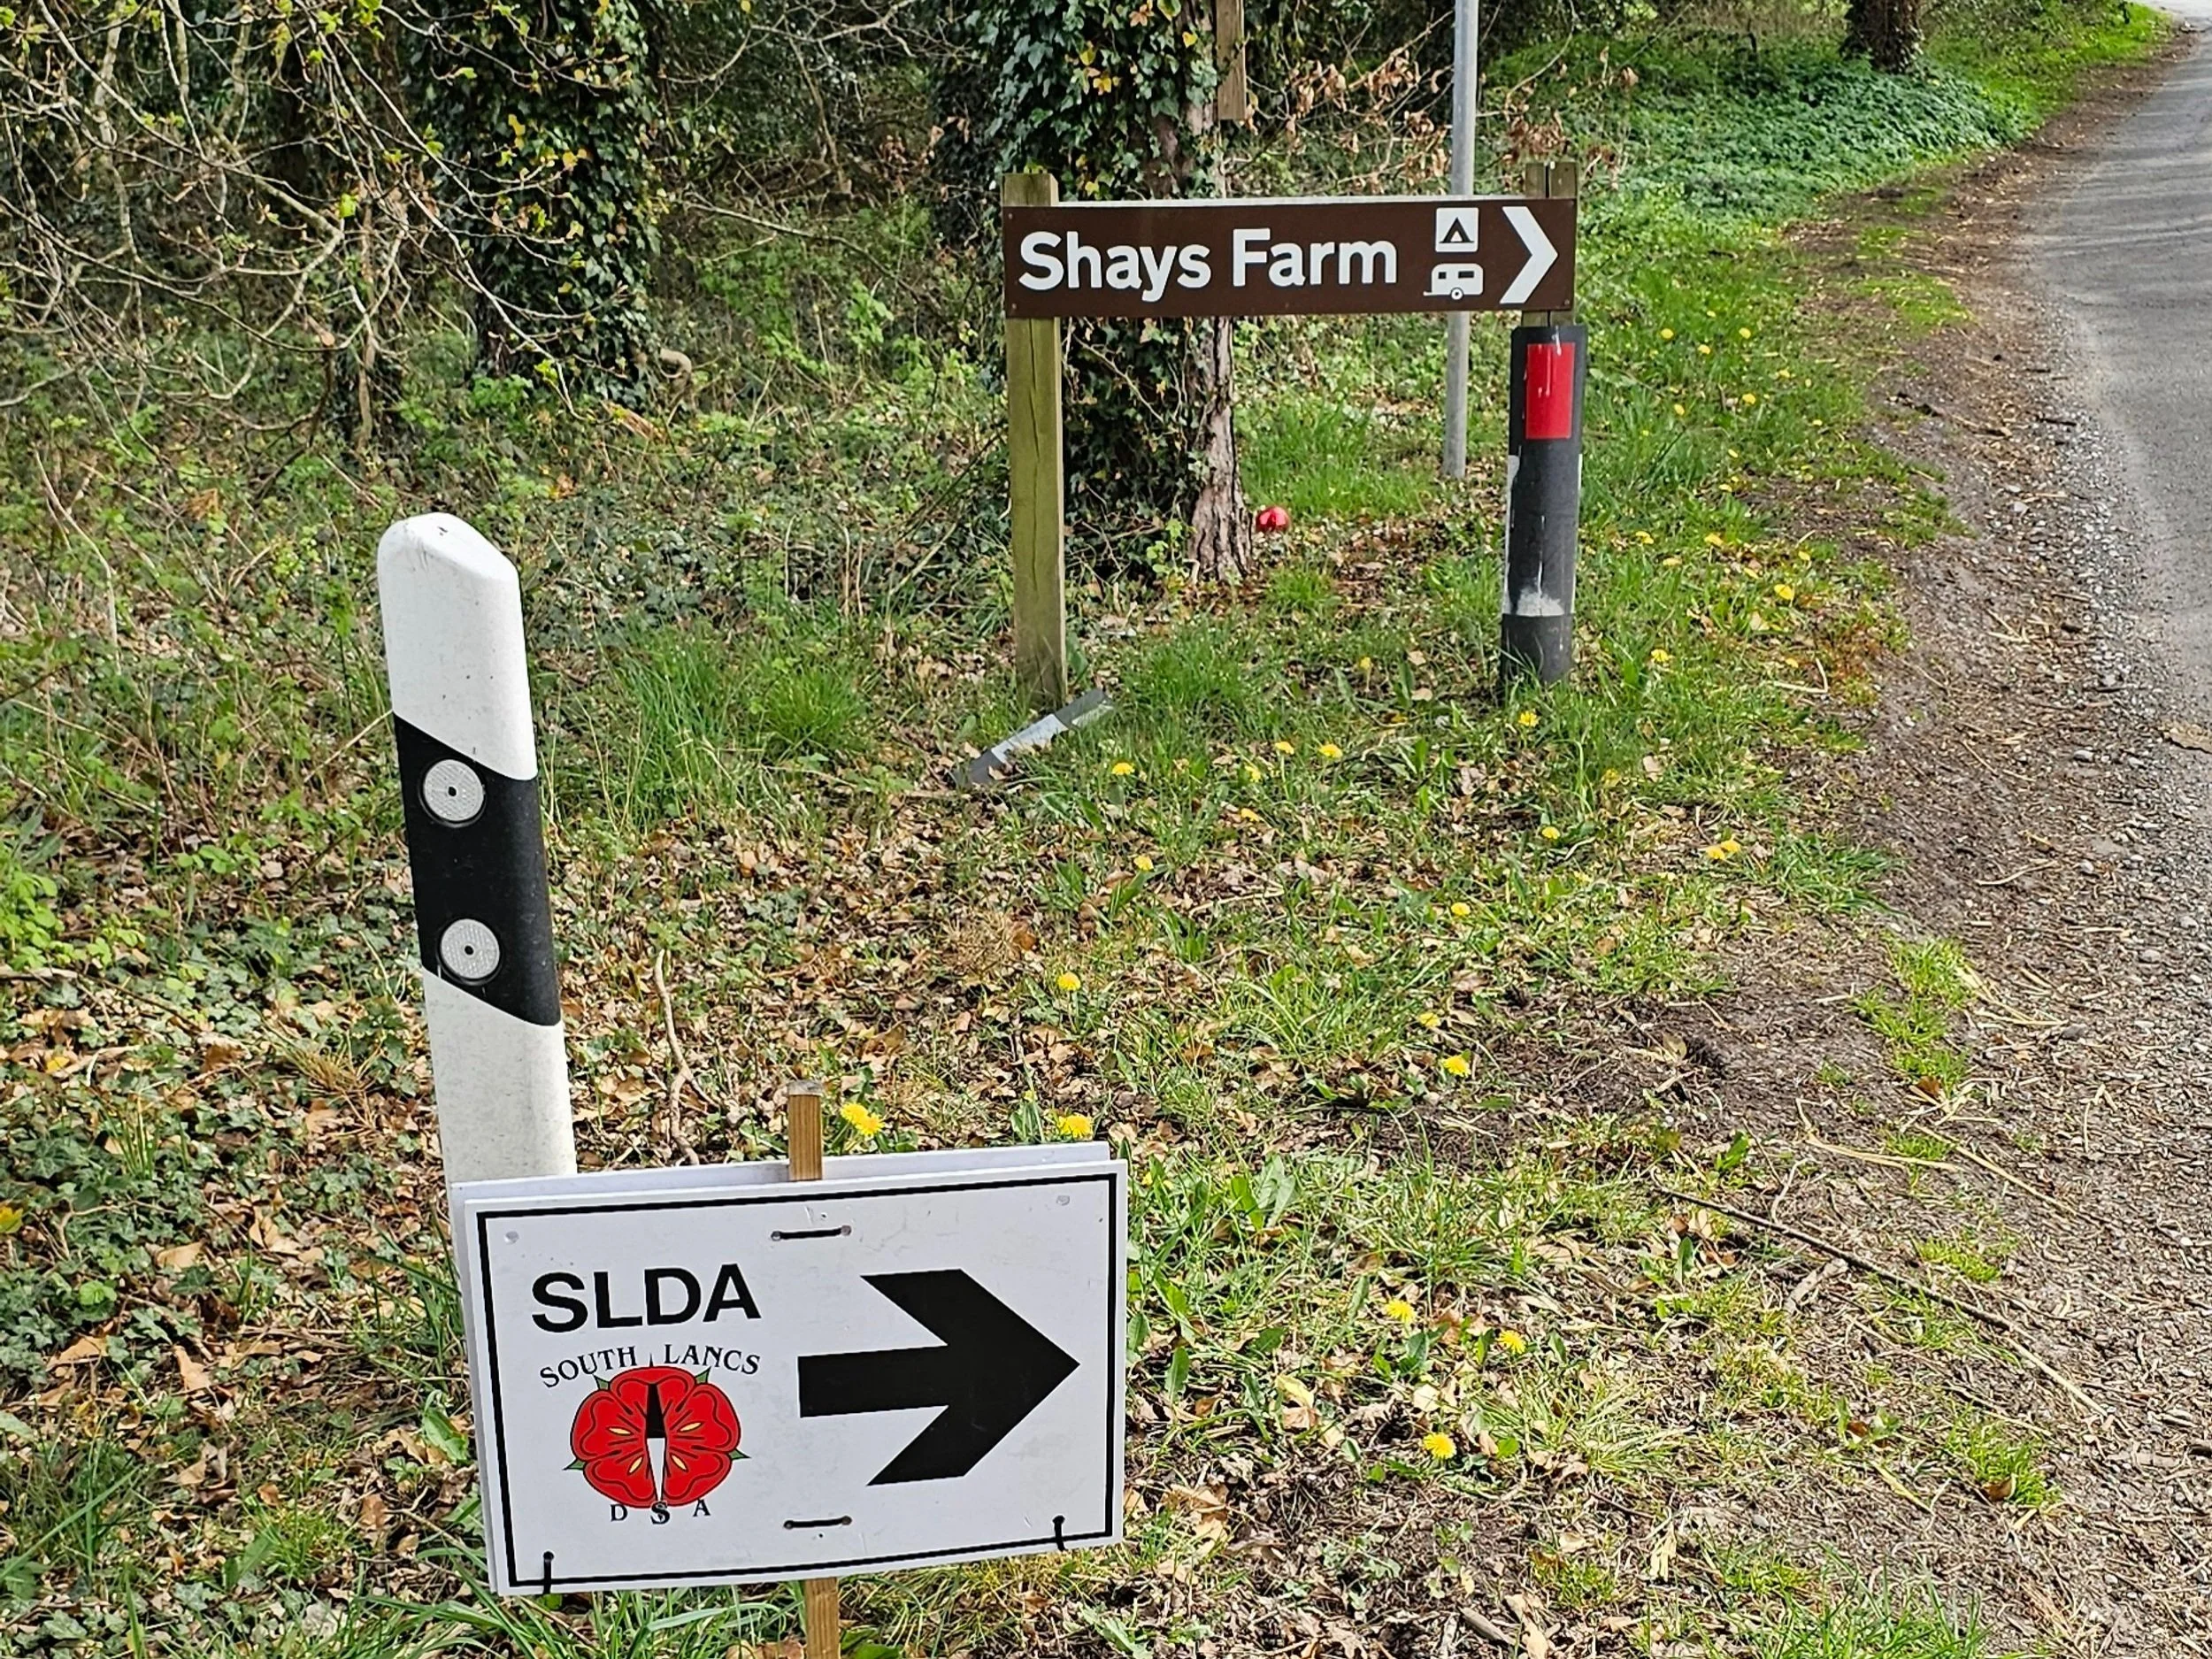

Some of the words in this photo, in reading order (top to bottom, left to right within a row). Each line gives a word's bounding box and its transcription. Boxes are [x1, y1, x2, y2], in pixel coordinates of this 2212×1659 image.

[1018, 230, 1211, 303] Shays
[1233, 227, 1397, 288] Farm
[531, 1263, 762, 1333] SLDA
[539, 1345, 638, 1388] SOUTH
[664, 1343, 761, 1375] LANCS
